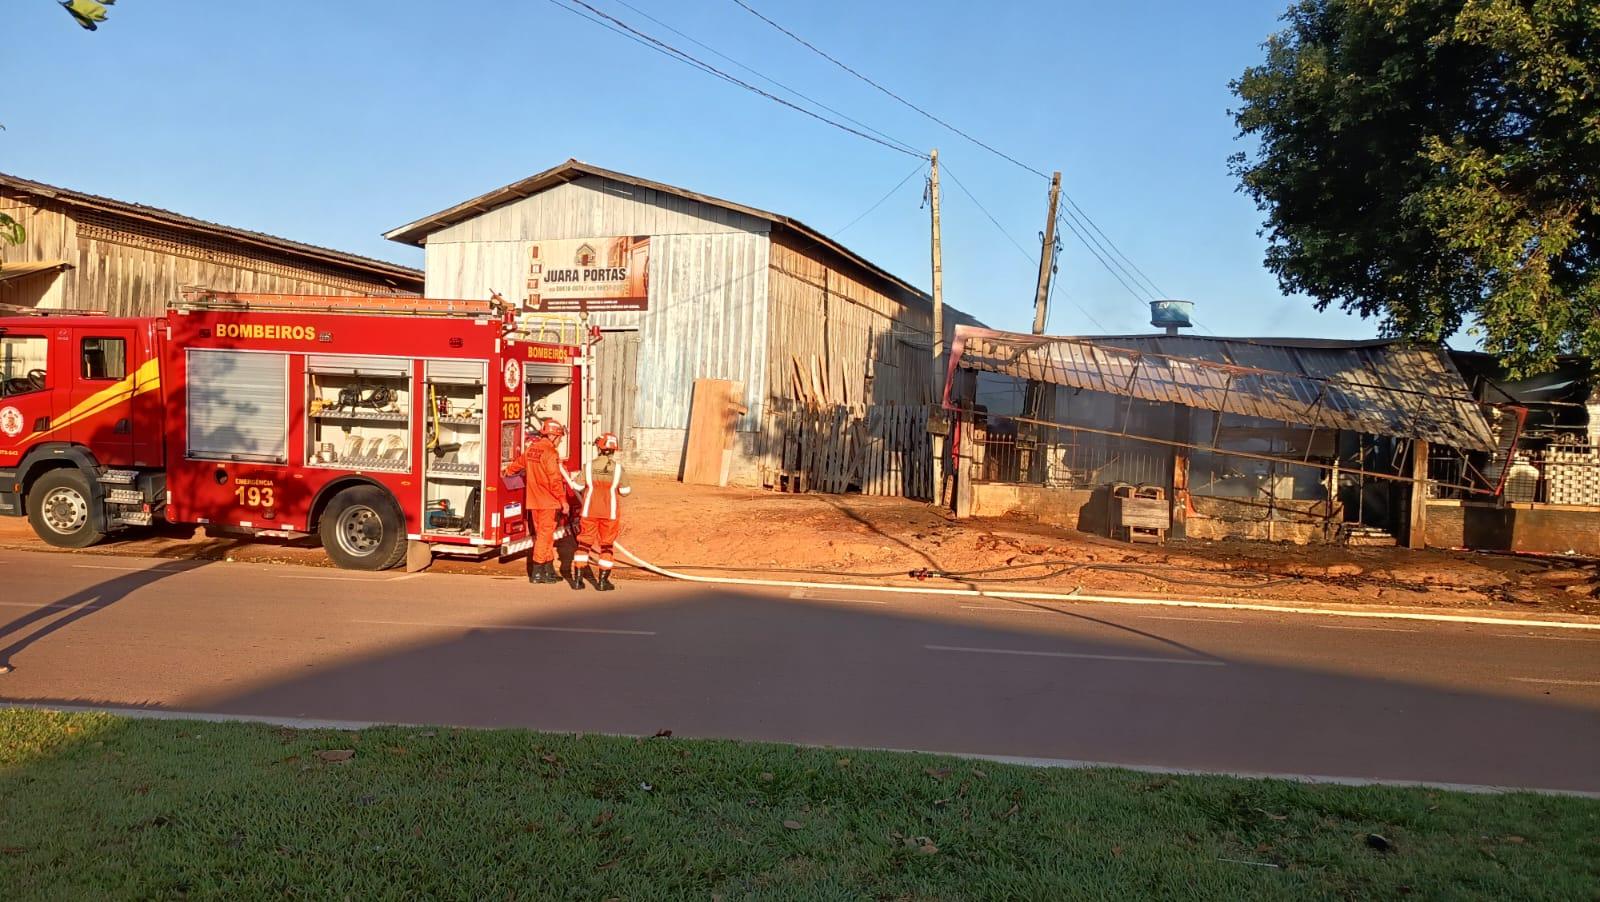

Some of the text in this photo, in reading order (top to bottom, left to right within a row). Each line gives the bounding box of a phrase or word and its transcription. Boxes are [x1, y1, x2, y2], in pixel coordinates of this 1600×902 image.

[544, 267, 627, 283] JUARA PORTAS
[216, 323, 316, 340] BOMBEIROS
[527, 346, 568, 360] BOMBEIROS
[502, 402, 520, 419] 193
[235, 485, 274, 507] 193
